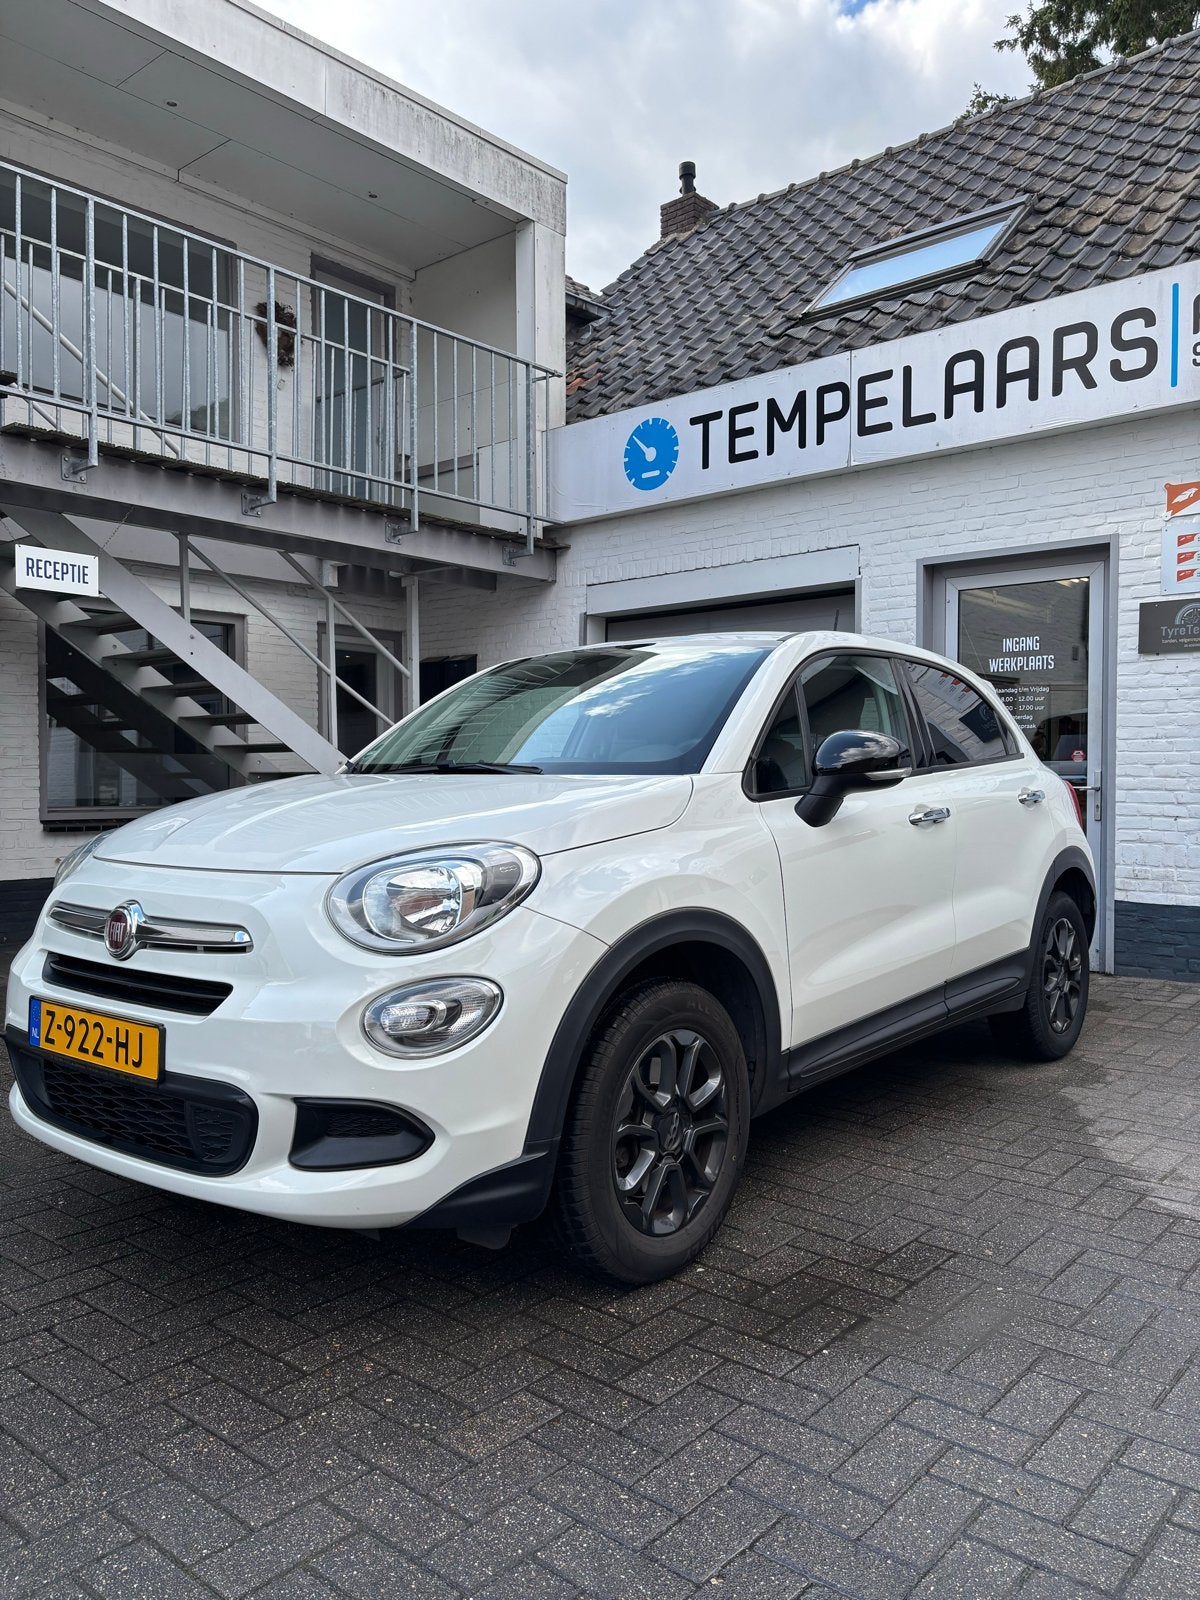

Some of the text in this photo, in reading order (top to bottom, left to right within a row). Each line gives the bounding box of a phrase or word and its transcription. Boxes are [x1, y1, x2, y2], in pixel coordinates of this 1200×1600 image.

[689, 306, 1158, 470] TEMPELAARS
[26, 557, 89, 584] RECEPTIE
[1002, 636, 1040, 653] INGANG
[988, 655, 1055, 673] WERKPLAATS
[1029, 685, 1050, 693] Vrijdag
[110, 921, 126, 942] FIAT
[31, 1026, 40, 1039] NL
[44, 1009, 144, 1069] Z-922-HJ
